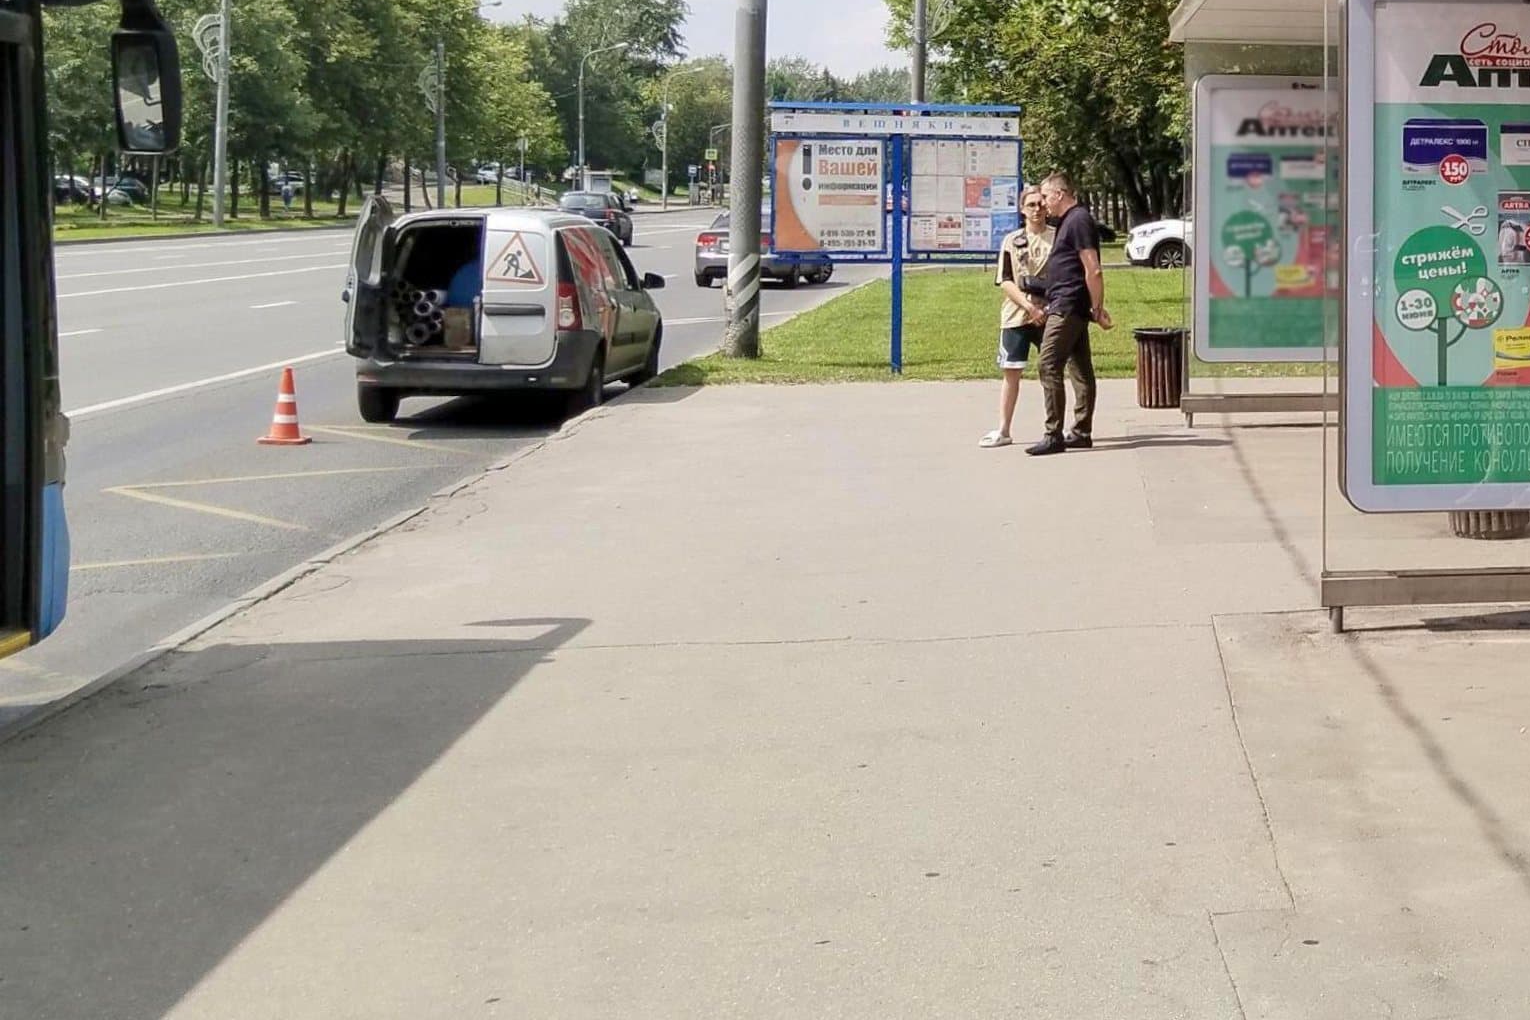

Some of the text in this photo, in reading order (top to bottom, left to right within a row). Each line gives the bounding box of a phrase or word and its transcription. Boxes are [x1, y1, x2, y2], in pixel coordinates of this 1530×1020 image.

[1469, 58, 1493, 67] сеть
[818, 144, 878, 156] Место для
[1410, 137, 1454, 146] ДЕТРАЛЕКС
[818, 158, 878, 176] Вашей
[1402, 246, 1474, 267] стрижём
[1418, 261, 1467, 280] цены!
[1400, 297, 1432, 311] 1-30
[1386, 423, 1450, 447] ИМЕЮТСЯ
[1386, 450, 1465, 474] ПОЛУЧЕНИЕ
